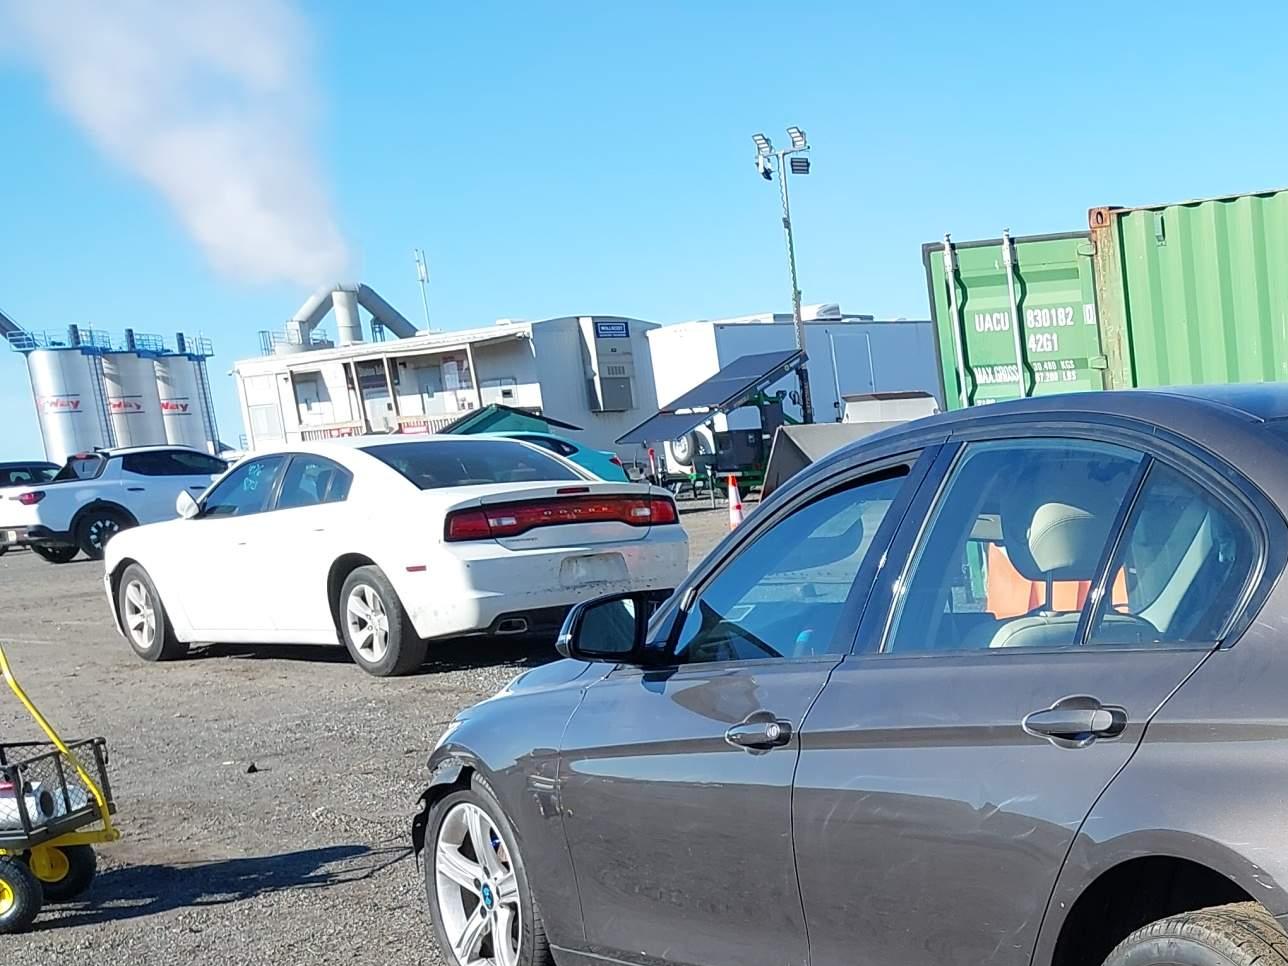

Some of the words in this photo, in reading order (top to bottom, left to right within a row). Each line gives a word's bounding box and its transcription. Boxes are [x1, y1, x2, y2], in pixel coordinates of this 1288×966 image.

[975, 312, 1009, 332] UACU
[1027, 307, 1074, 328] 830182
[1028, 333, 1058, 352] 42G1
[1060, 360, 1075, 369] KGS
